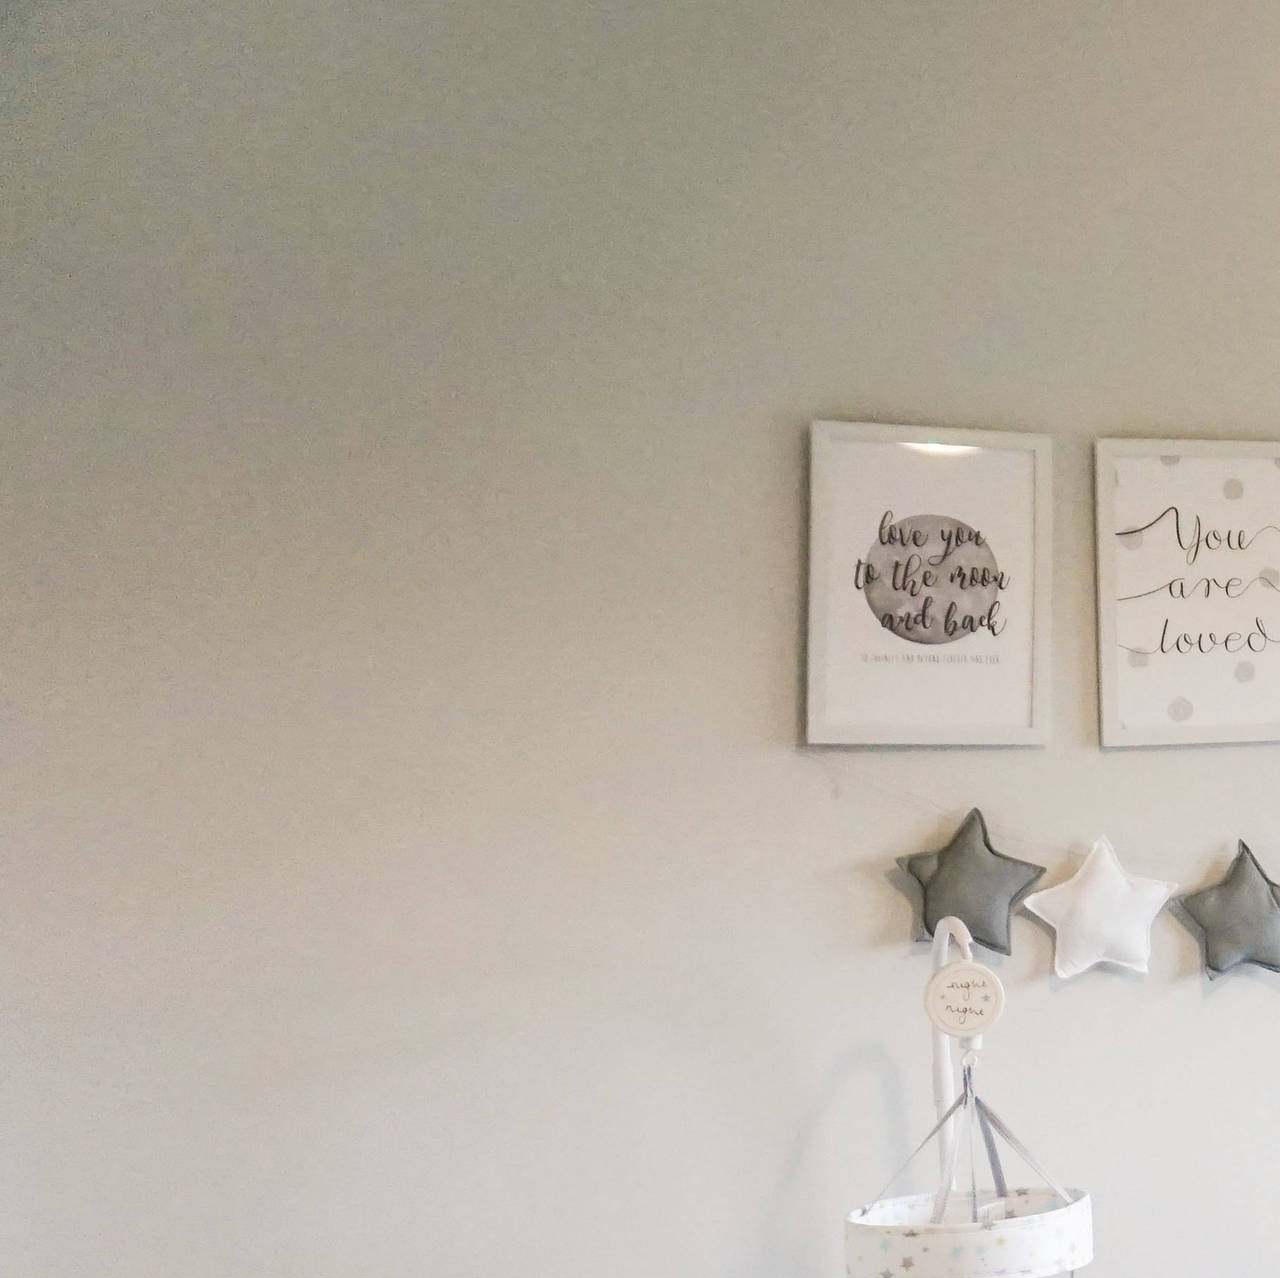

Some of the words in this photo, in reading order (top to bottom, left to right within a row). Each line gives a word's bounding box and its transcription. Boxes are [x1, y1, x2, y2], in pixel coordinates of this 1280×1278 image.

[879, 510, 928, 547] love
[928, 525, 987, 566] you
[854, 558, 880, 589] to
[892, 554, 937, 596] the
[950, 565, 1010, 590] moon
[881, 596, 934, 631] and
[944, 600, 1006, 636] back
